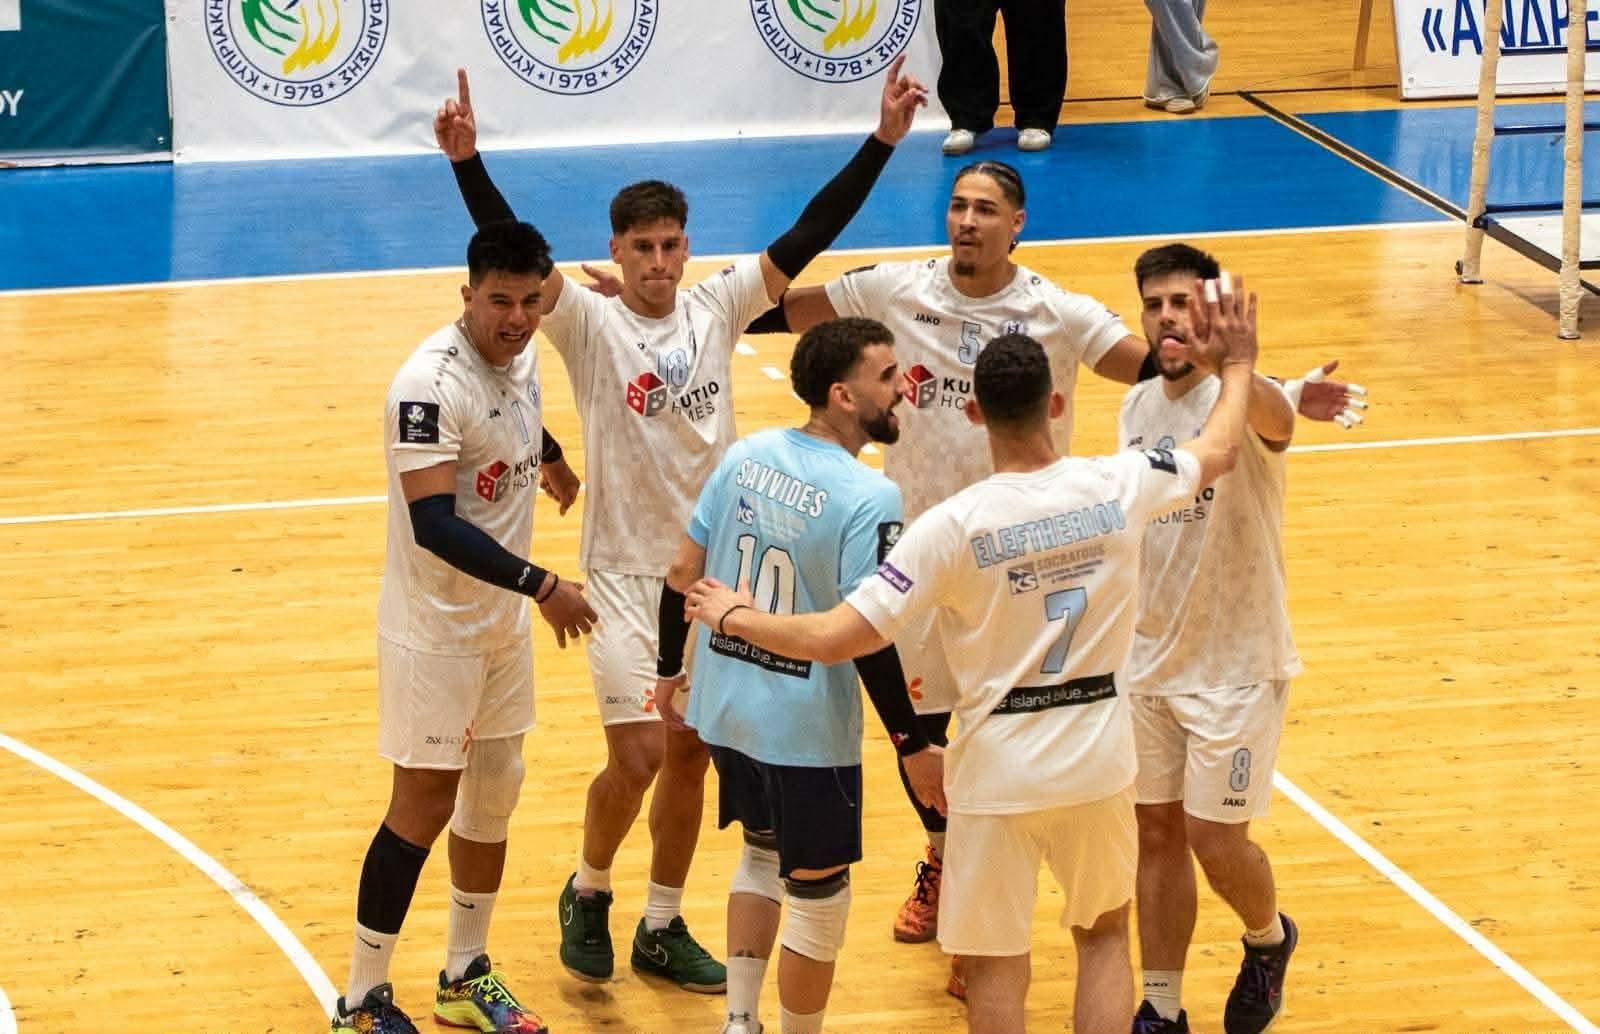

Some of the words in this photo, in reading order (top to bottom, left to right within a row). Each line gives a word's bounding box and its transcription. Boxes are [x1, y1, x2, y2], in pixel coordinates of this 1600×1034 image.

[610, 0, 654, 75] ΑΙΡΙΣΗΣ
[756, 0, 803, 65] ΚΥΠΡΙΑ
[549, 71, 598, 89] 1978
[815, 60, 863, 77] 1978
[273, 83, 324, 100] 1978
[914, 313, 940, 326] JAKO
[958, 320, 982, 365] 5
[943, 376, 970, 394] KU
[736, 457, 829, 518] SAVVIDES
[970, 499, 1126, 569] ELEFTHERIOU
[736, 534, 797, 615] 10
[1010, 573, 1039, 595] KS
[1040, 586, 1088, 674] 7
[1010, 688, 1051, 708] island
[1230, 747, 1252, 792] 8
[1222, 797, 1247, 807] JAKO
